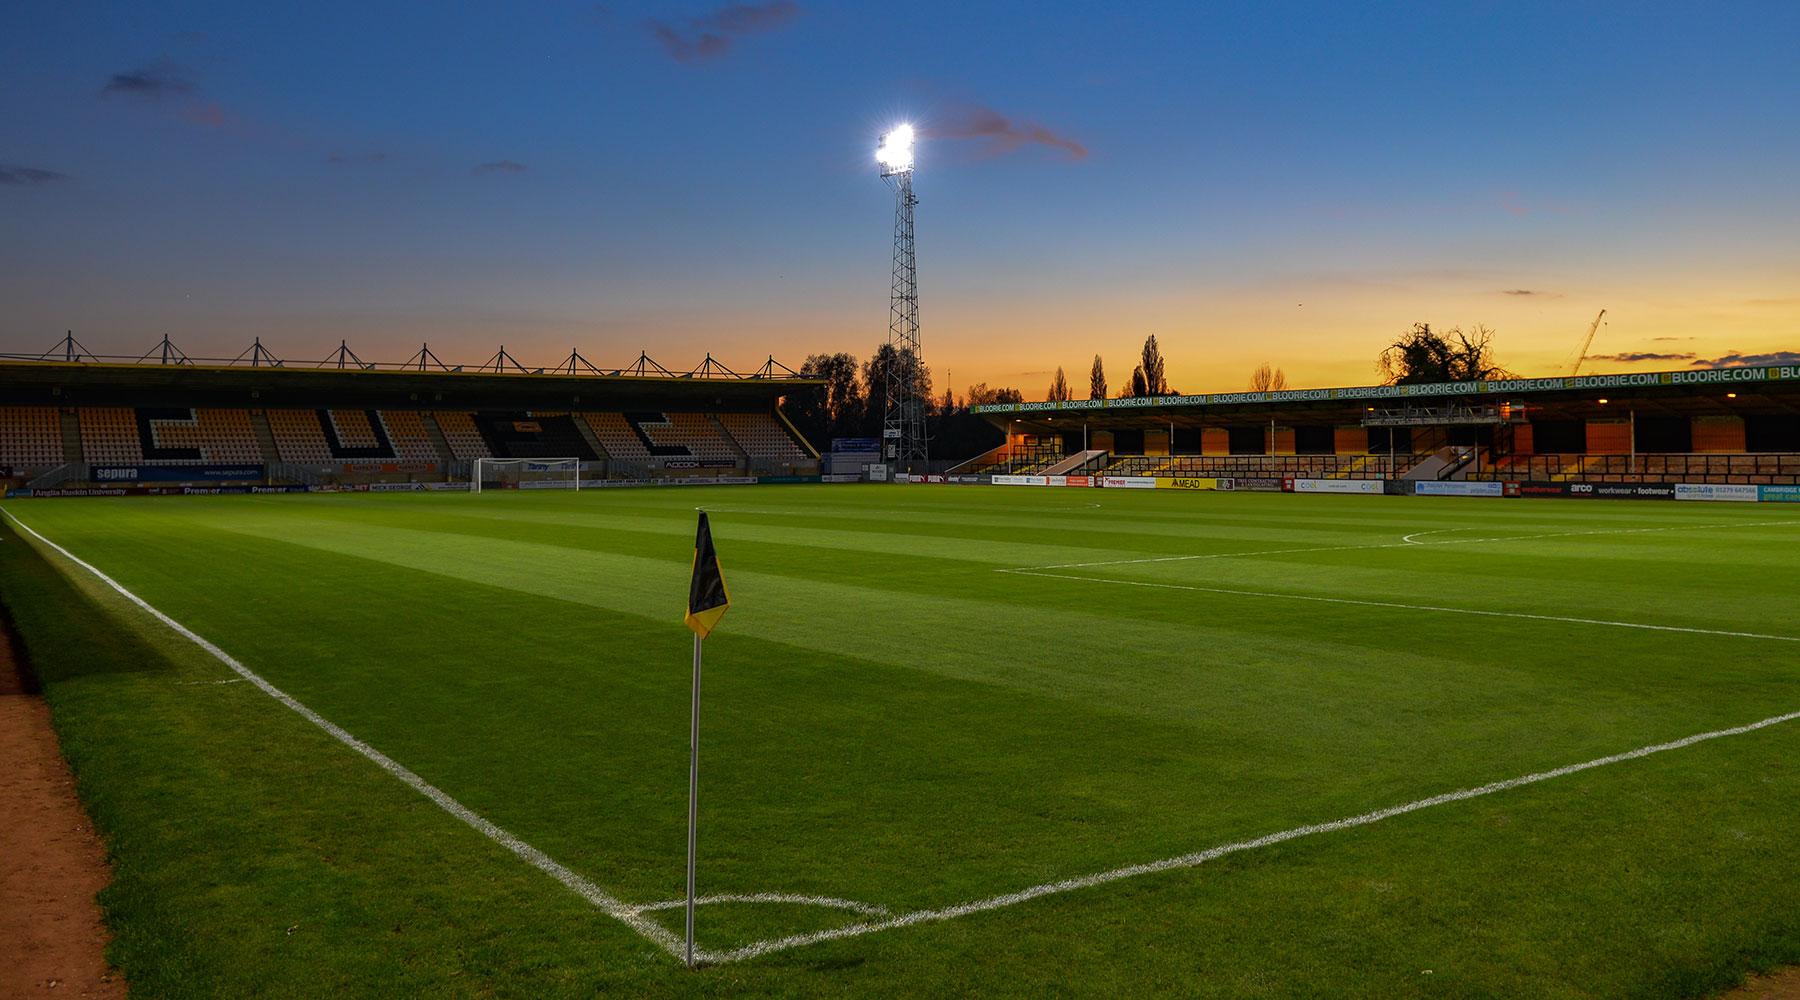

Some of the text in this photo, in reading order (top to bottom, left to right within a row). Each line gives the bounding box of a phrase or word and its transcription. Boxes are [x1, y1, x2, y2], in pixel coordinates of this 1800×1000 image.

[1020, 402, 1057, 411] BLOORIE.COM
[1062, 400, 1103, 409] BLOORIE.COM
[1108, 398, 1153, 407] BLOORIE.COM
[1158, 396, 1206, 405] BLOORIE.COM
[1213, 393, 1266, 404] BLOORIE.COM
[1272, 391, 1329, 400] BLOORIE.COM
[1337, 388, 1400, 398] BLOORIE.COM
[1409, 383, 1477, 395] BLOORIE.COM
[1487, 379, 1563, 392] BLOORIE.COM
[1574, 375, 1659, 388] BLOORIE.COM
[1672, 369, 1766, 384] BLOORIE.COM
[1780, 366, 1800, 378] BL
[96, 468, 138, 480] sepura
[1179, 479, 1200, 489] MEAD
[1570, 484, 1593, 493] arco
[35, 489, 59, 497] Anglia
[61, 488, 86, 496] Ruskin
[88, 488, 126, 496] University
[1598, 488, 1633, 496] workwear
[1637, 487, 1670, 496] footwear
